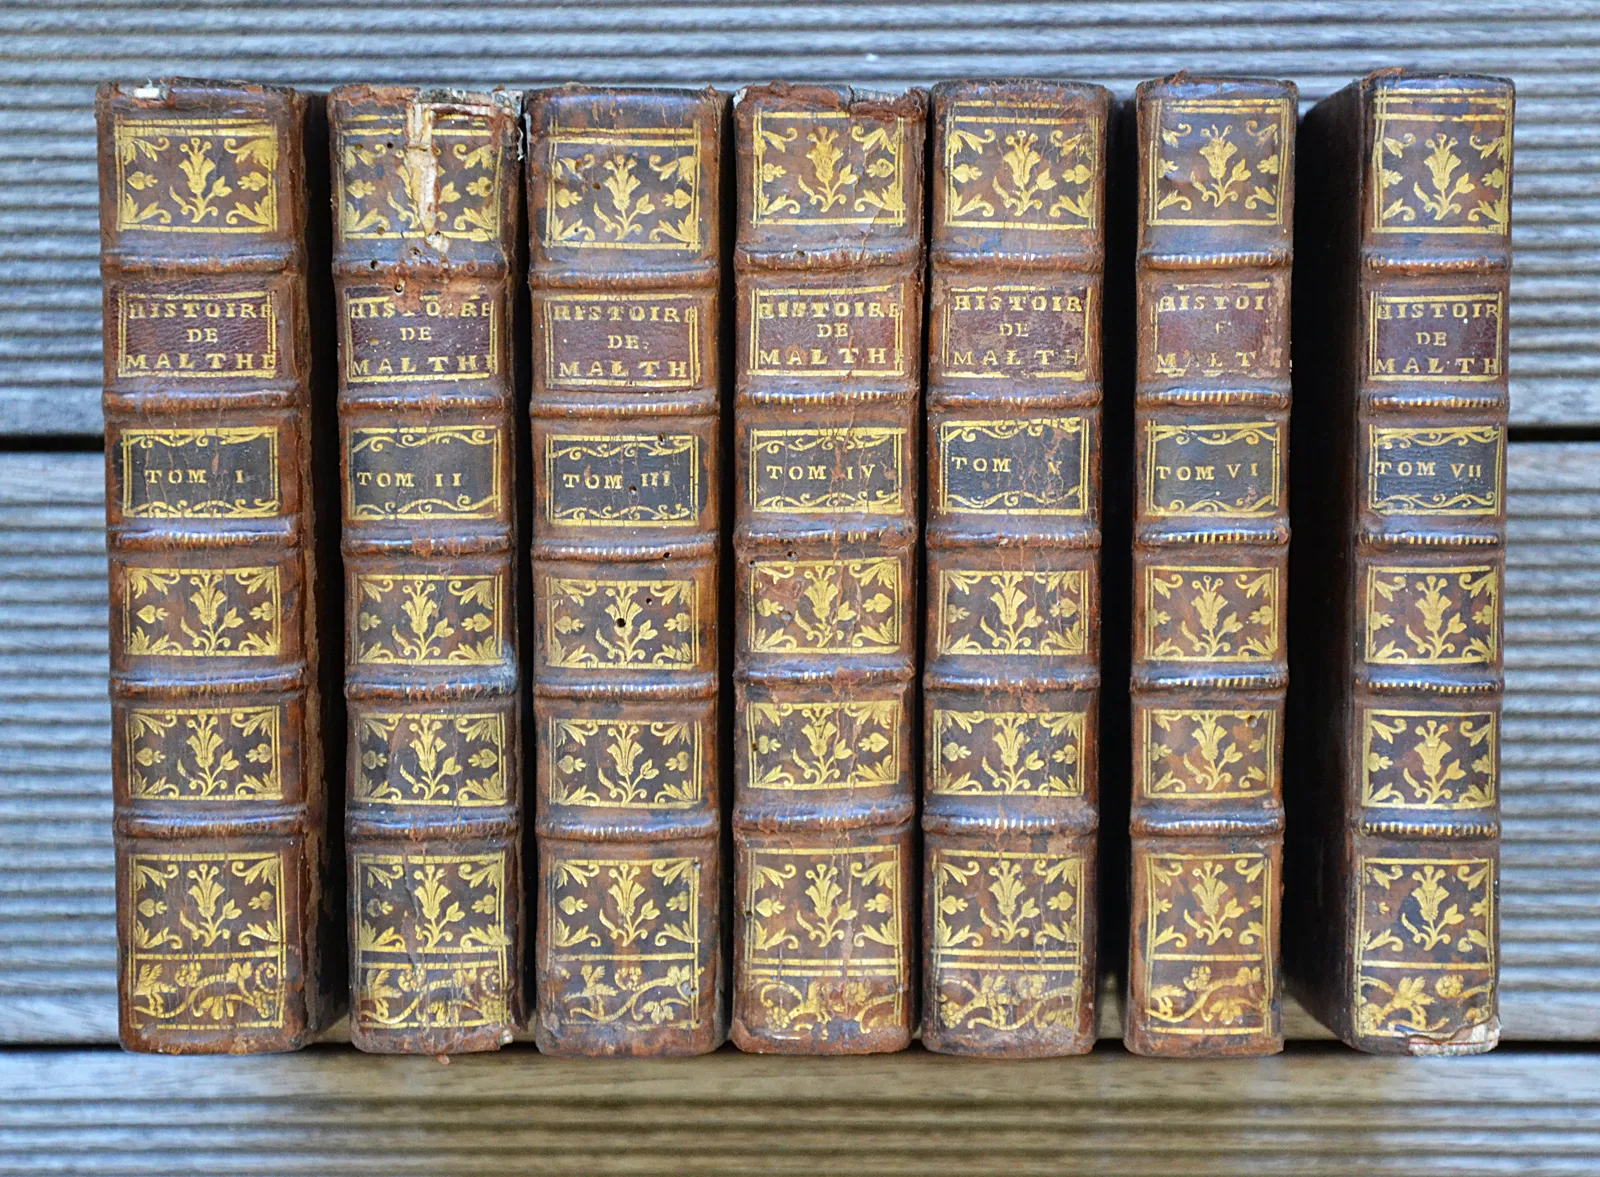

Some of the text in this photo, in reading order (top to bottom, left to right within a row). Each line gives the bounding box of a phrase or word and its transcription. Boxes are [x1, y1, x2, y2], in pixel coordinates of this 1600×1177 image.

[351, 302, 491, 319] HISORE
[954, 295, 1083, 312] HISTOIR
[186, 328, 219, 343] DE
[399, 327, 432, 341] DE
[816, 323, 849, 338] DE
[999, 322, 1029, 337] DE
[607, 335, 639, 350] DE
[1416, 332, 1447, 346] DE
[766, 464, 876, 480] TOM IV
[951, 456, 1011, 472] TOM
[1156, 463, 1258, 481] TOM VI
[1376, 461, 1482, 478] TOM VII
[144, 469, 243, 484] TOM I
[357, 472, 461, 488] TOM II
[562, 470, 671, 490] TOM III
